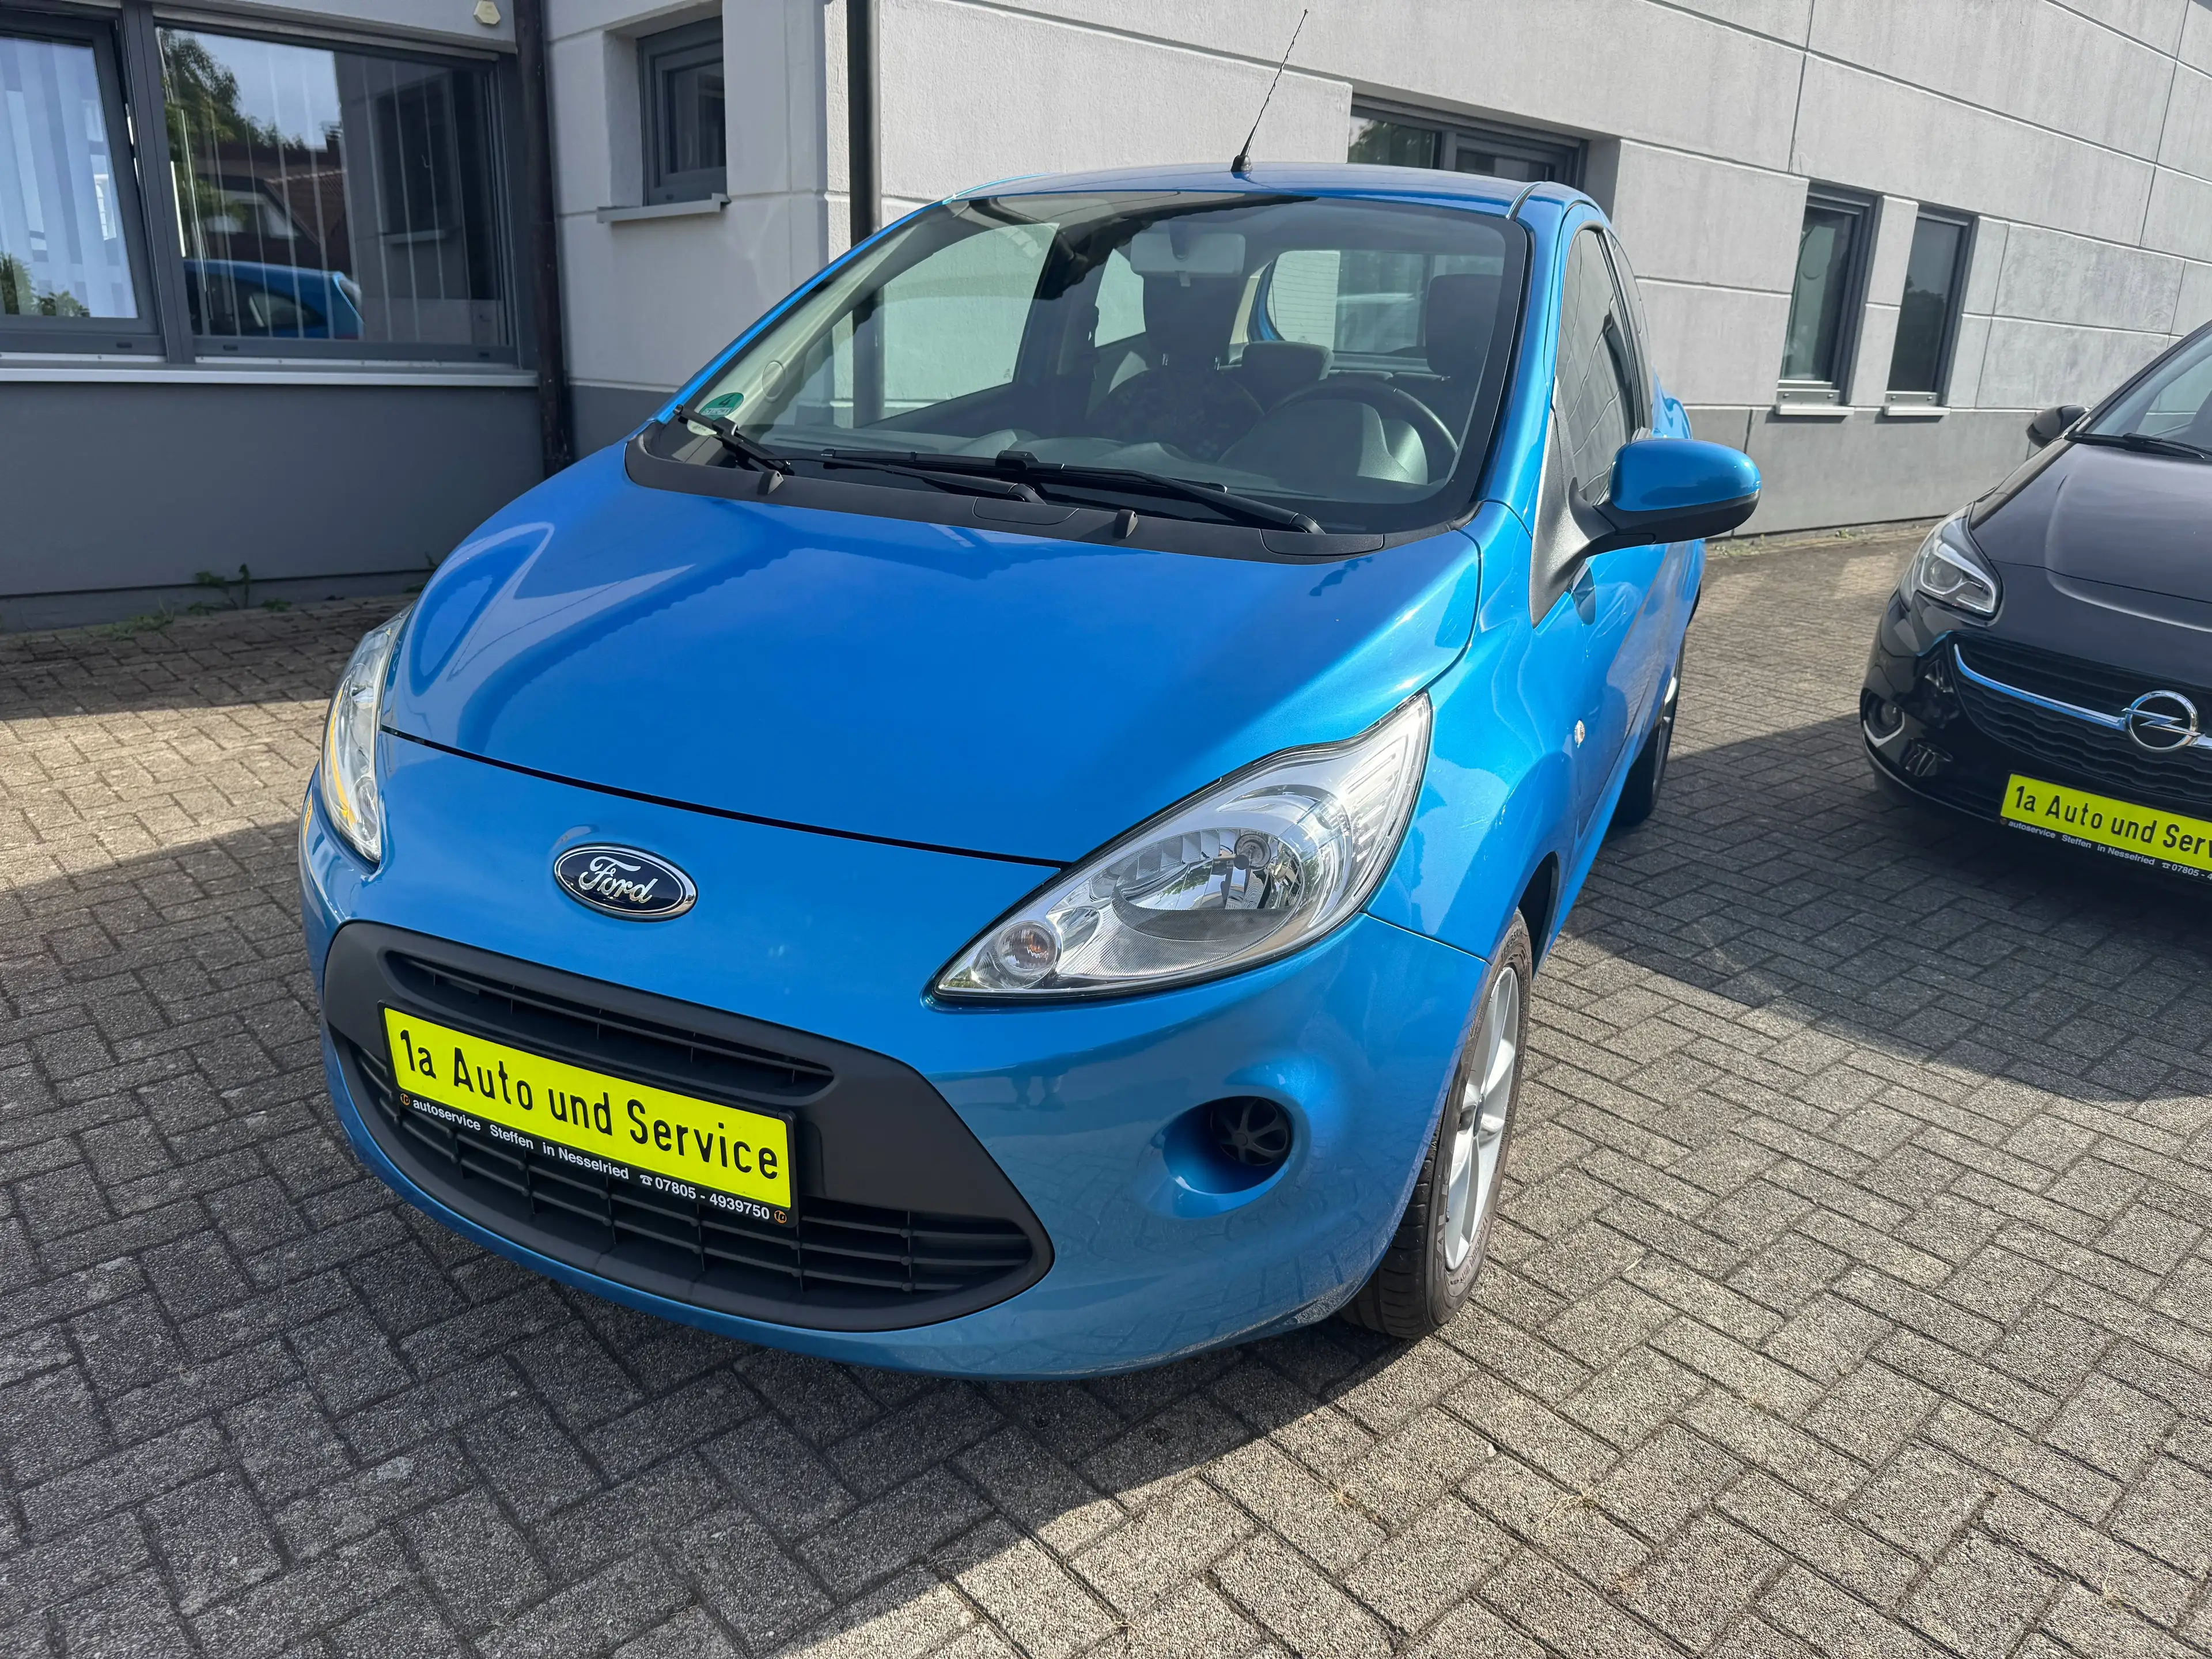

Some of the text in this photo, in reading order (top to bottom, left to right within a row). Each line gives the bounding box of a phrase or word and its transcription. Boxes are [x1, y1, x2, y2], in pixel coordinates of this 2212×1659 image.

[2008, 821, 2056, 838] autoservice
[2061, 834, 2092, 849] Steffen
[2097, 843, 2106, 853] in
[2107, 847, 2156, 866] Nesselried
[2171, 863, 2200, 877] 07805
[2016, 785, 2212, 858] 1a Auto und Ser
[578, 855, 658, 904] Ford
[400, 1029, 778, 1180] 1a Auto und Service
[412, 1099, 482, 1131] autoservice
[490, 1123, 534, 1150] Steffen
[542, 1142, 555, 1157] in
[558, 1146, 630, 1180] Nesselried
[655, 1176, 696, 1199] 07805
[709, 1193, 770, 1219] 4939750
